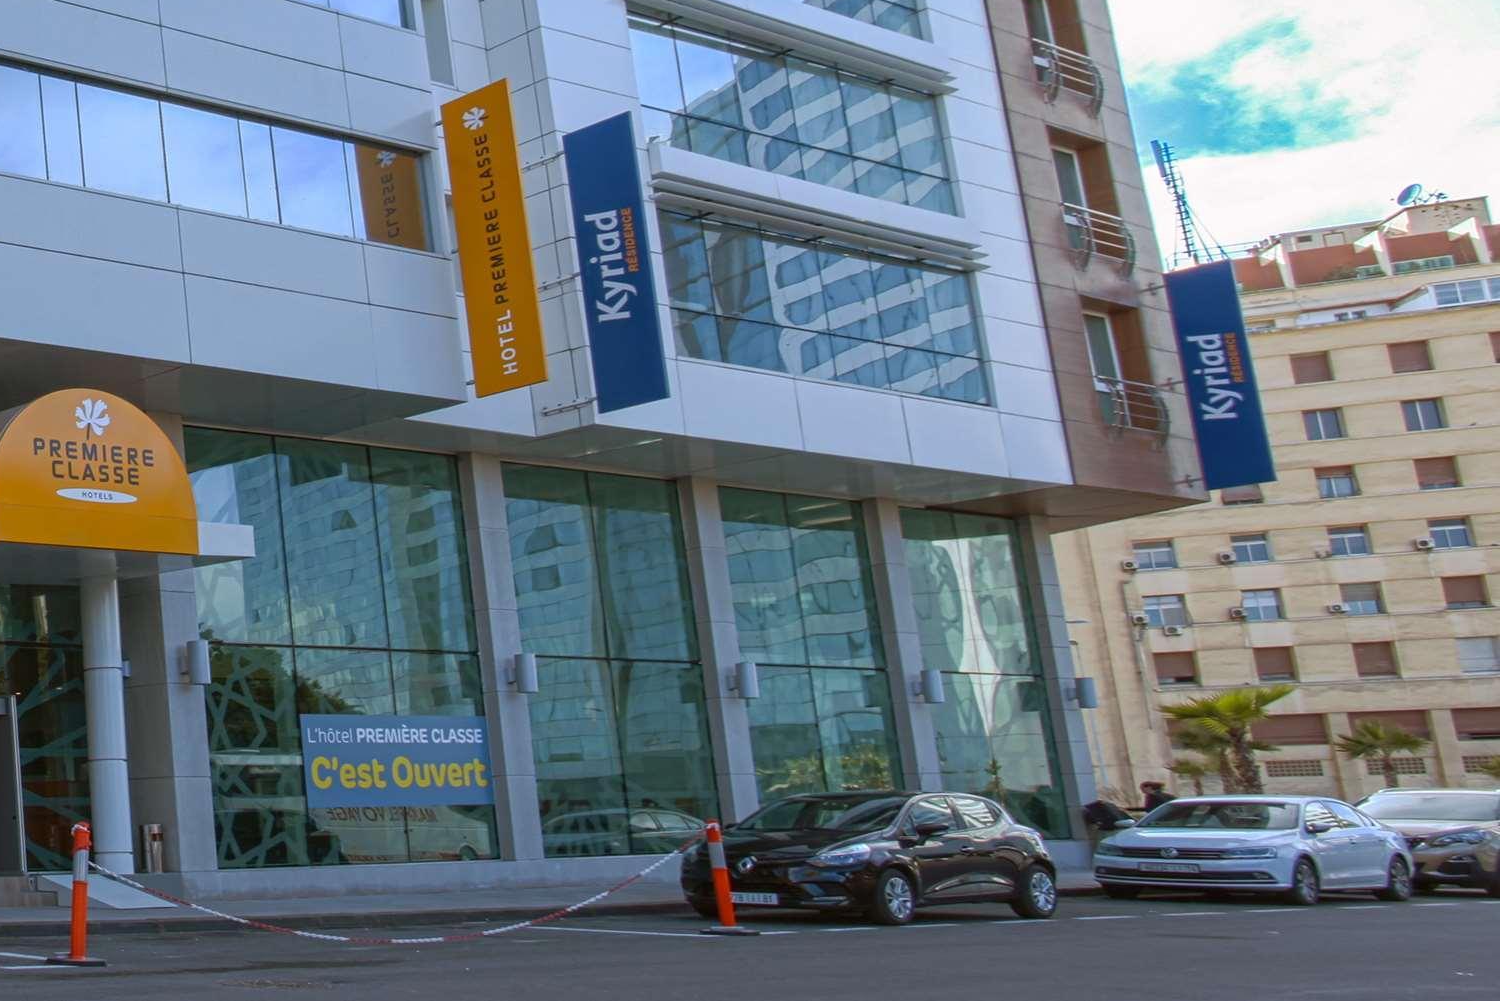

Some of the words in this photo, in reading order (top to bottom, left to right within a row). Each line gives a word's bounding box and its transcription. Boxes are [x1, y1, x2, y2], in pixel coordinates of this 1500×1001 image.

[474, 132, 499, 203] CLASSE
[484, 208, 510, 305] PREMIERE
[584, 208, 637, 323] Kyriad
[495, 308, 518, 376] HOTEL
[1186, 333, 1243, 421] Kyriad
[33, 437, 154, 468] PREMIERE
[51, 460, 140, 486] CLASSE
[81, 491, 114, 501] HOTELS
[307, 727, 353, 745] L'hôtel
[356, 723, 429, 744] PREMIÈRE
[431, 728, 483, 744] CLASSE
[311, 755, 385, 790] C'est
[391, 756, 489, 789] Ouvert
